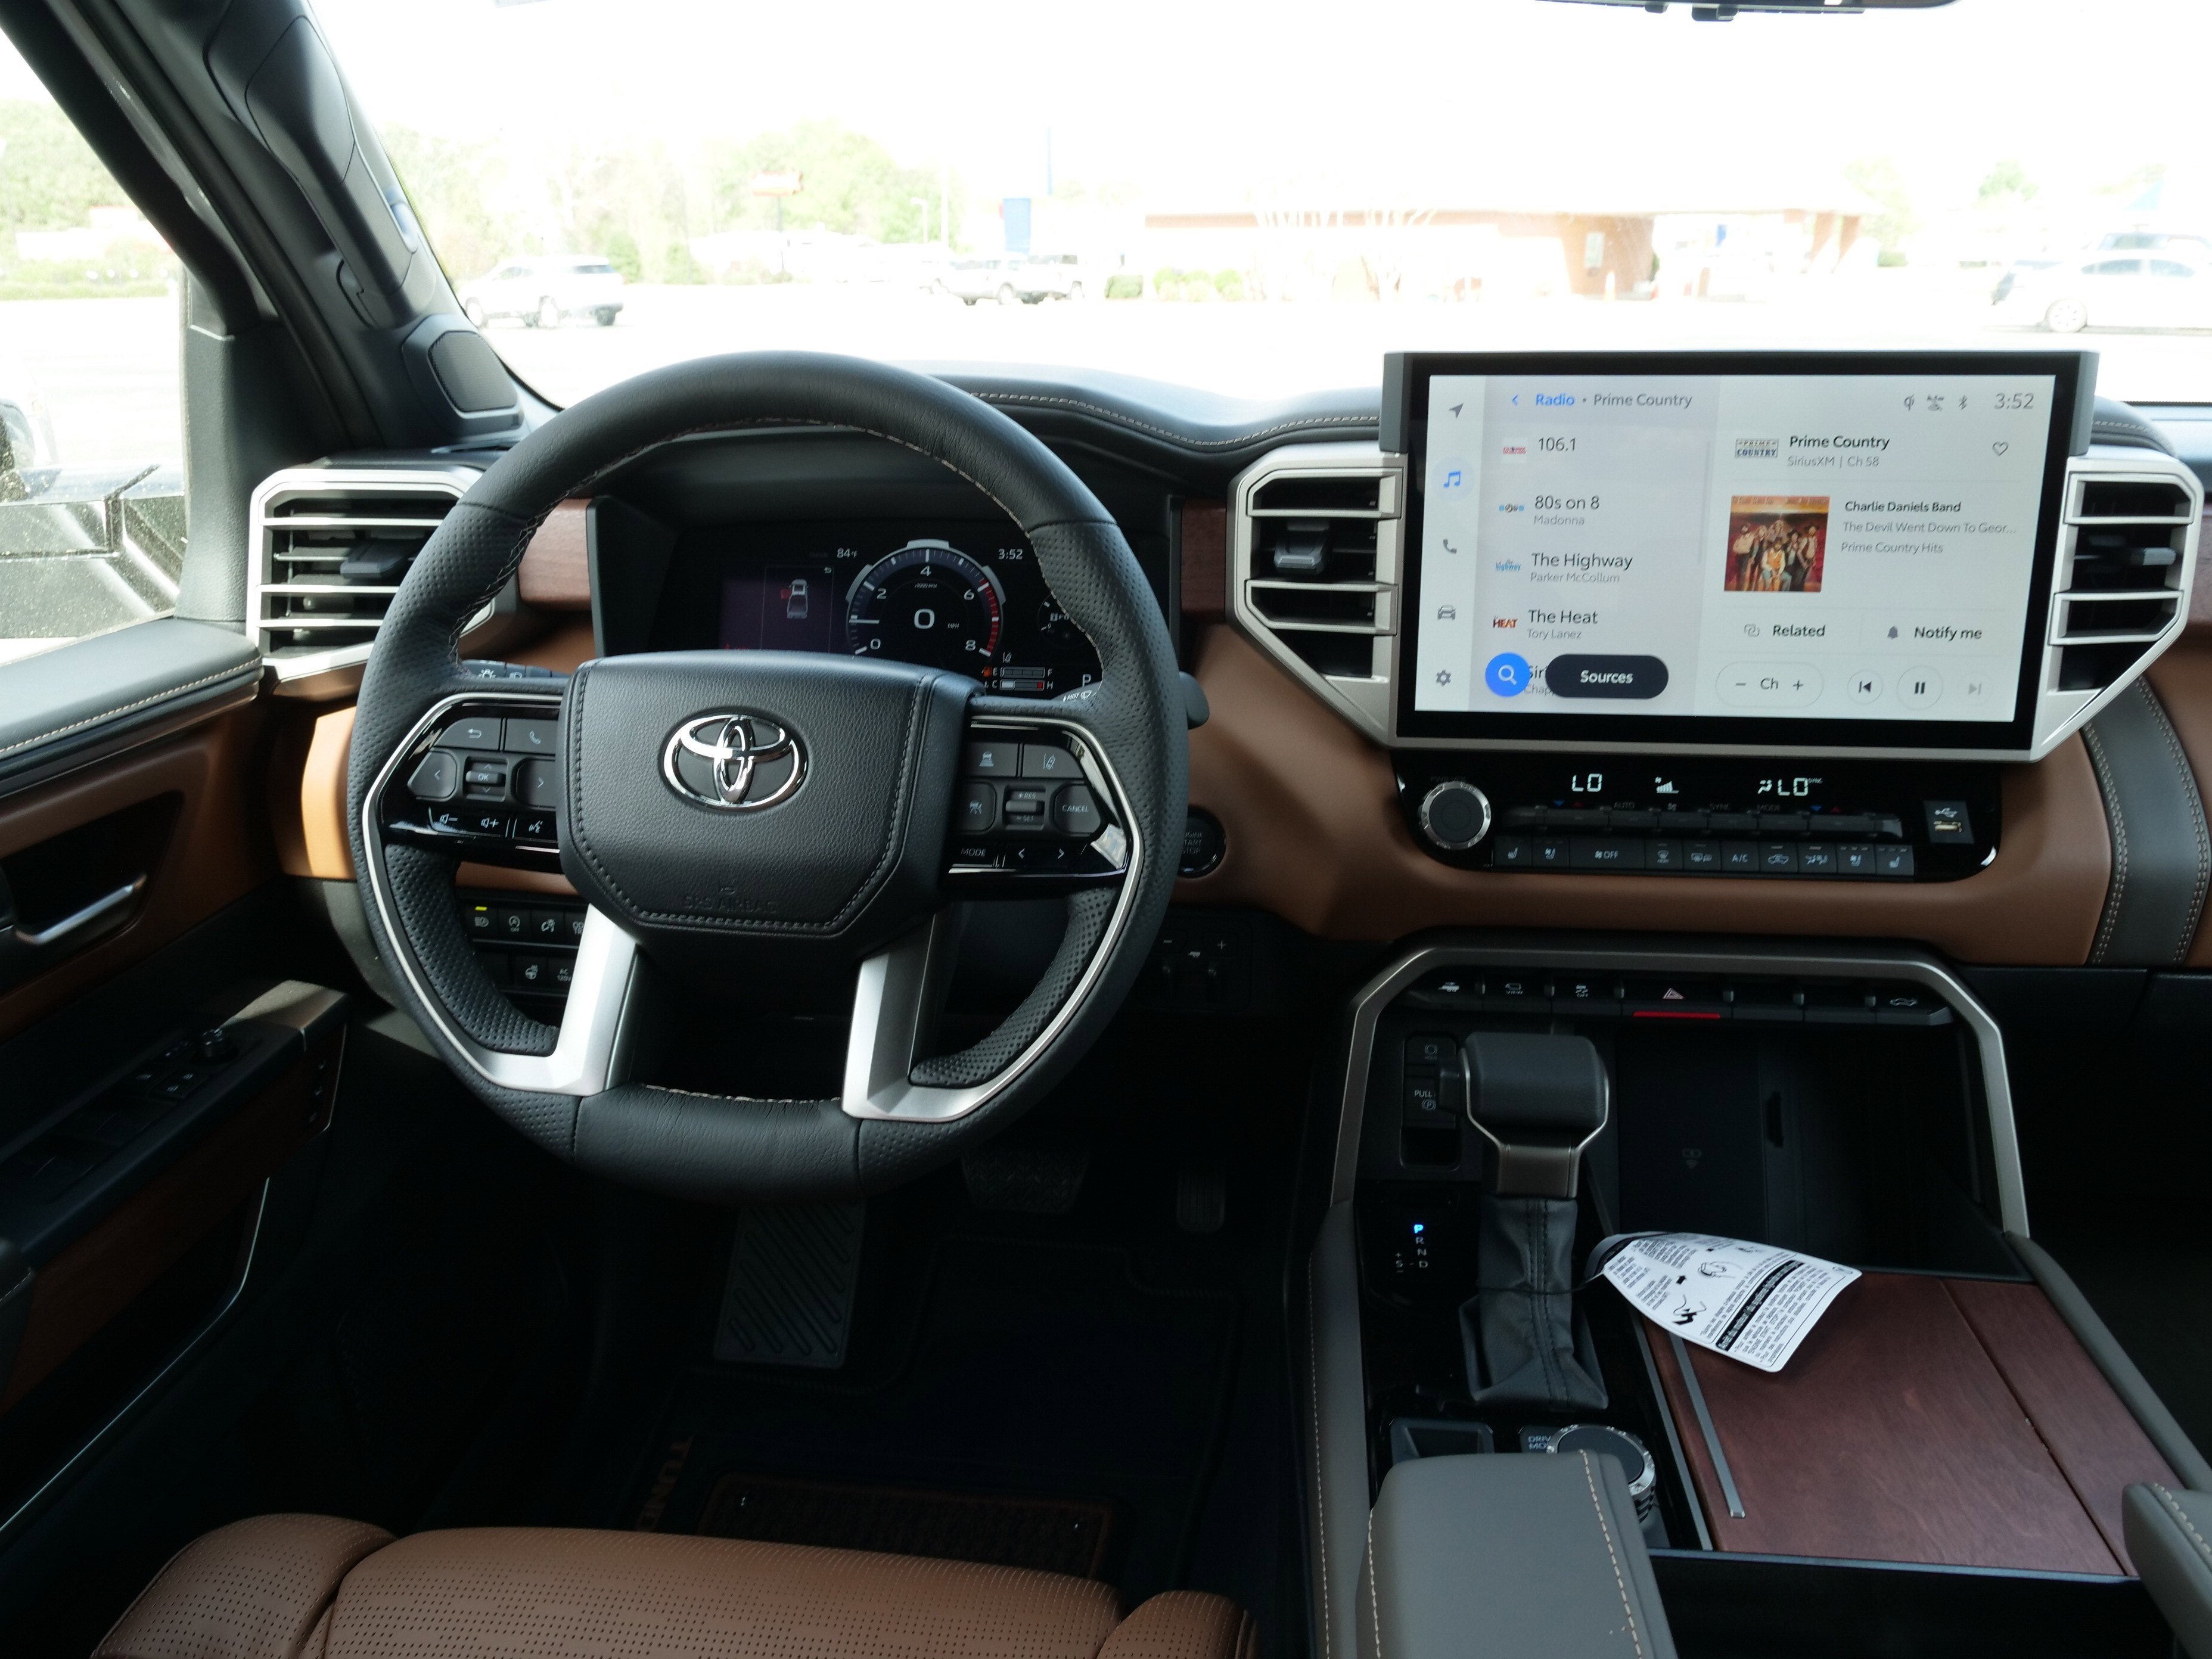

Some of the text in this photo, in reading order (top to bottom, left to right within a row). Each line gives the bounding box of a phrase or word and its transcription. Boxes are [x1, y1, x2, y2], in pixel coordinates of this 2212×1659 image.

[1536, 394, 1693, 408] Radio Prime Country
[1994, 393, 2034, 409] 3:52
[1539, 437, 1576, 452] 106.1
[1790, 435, 1890, 451] Prime Country
[1788, 455, 1835, 467] SiriusXM
[1847, 456, 1862, 467] Ch
[1866, 456, 1879, 467] 58
[1535, 495, 1562, 510] 80s
[1566, 498, 1586, 510] on
[1590, 495, 1599, 510] 8
[1845, 501, 1961, 513] Charlie Daniels Band
[1534, 515, 1585, 526] Madonna
[1843, 522, 1863, 533] The
[1865, 522, 1893, 533] Devil
[1896, 523, 1925, 533] Went
[1928, 523, 1961, 534] Down
[1964, 523, 1977, 534] To
[1841, 542, 1943, 555] Prime Country Hits
[998, 549, 1023, 560] 3:52
[1532, 553, 1633, 571] The Highway
[920, 566, 931, 577] 4
[1530, 572, 1620, 584] Parker McCollum
[877, 589, 887, 599] 2
[964, 590, 975, 600] 6
[914, 608, 935, 629] 0
[1528, 609, 1598, 624] The Heat
[1492, 619, 1518, 629] HEAT
[1528, 629, 1582, 641] Tory Lanez
[1772, 625, 1826, 638] Related
[1915, 626, 1983, 642] Notify me
[870, 638, 881, 650] 0
[965, 640, 976, 651] 8
[993, 667, 998, 676] E
[1048, 668, 1053, 677] F
[1082, 674, 1091, 687] P
[1580, 670, 1633, 685] Sources
[992, 679, 998, 688] C
[1047, 681, 1053, 689] H
[1760, 678, 1779, 690] Ch
[478, 773, 488, 781] OK
[1572, 773, 1602, 792] LO
[1778, 778, 1809, 796] LO
[1062, 805, 1089, 813] CANCEL
[961, 848, 986, 857] MODE
[1604, 850, 1618, 859] OFF
[1732, 855, 1748, 863] A/C
[1414, 1089, 1432, 1098] PULL
[1413, 1224, 1424, 1234] P
[1415, 1236, 1425, 1245] R
[1417, 1248, 1427, 1256] N
[1418, 1260, 1428, 1269] D
[1528, 1435, 1552, 1443] DRIV
